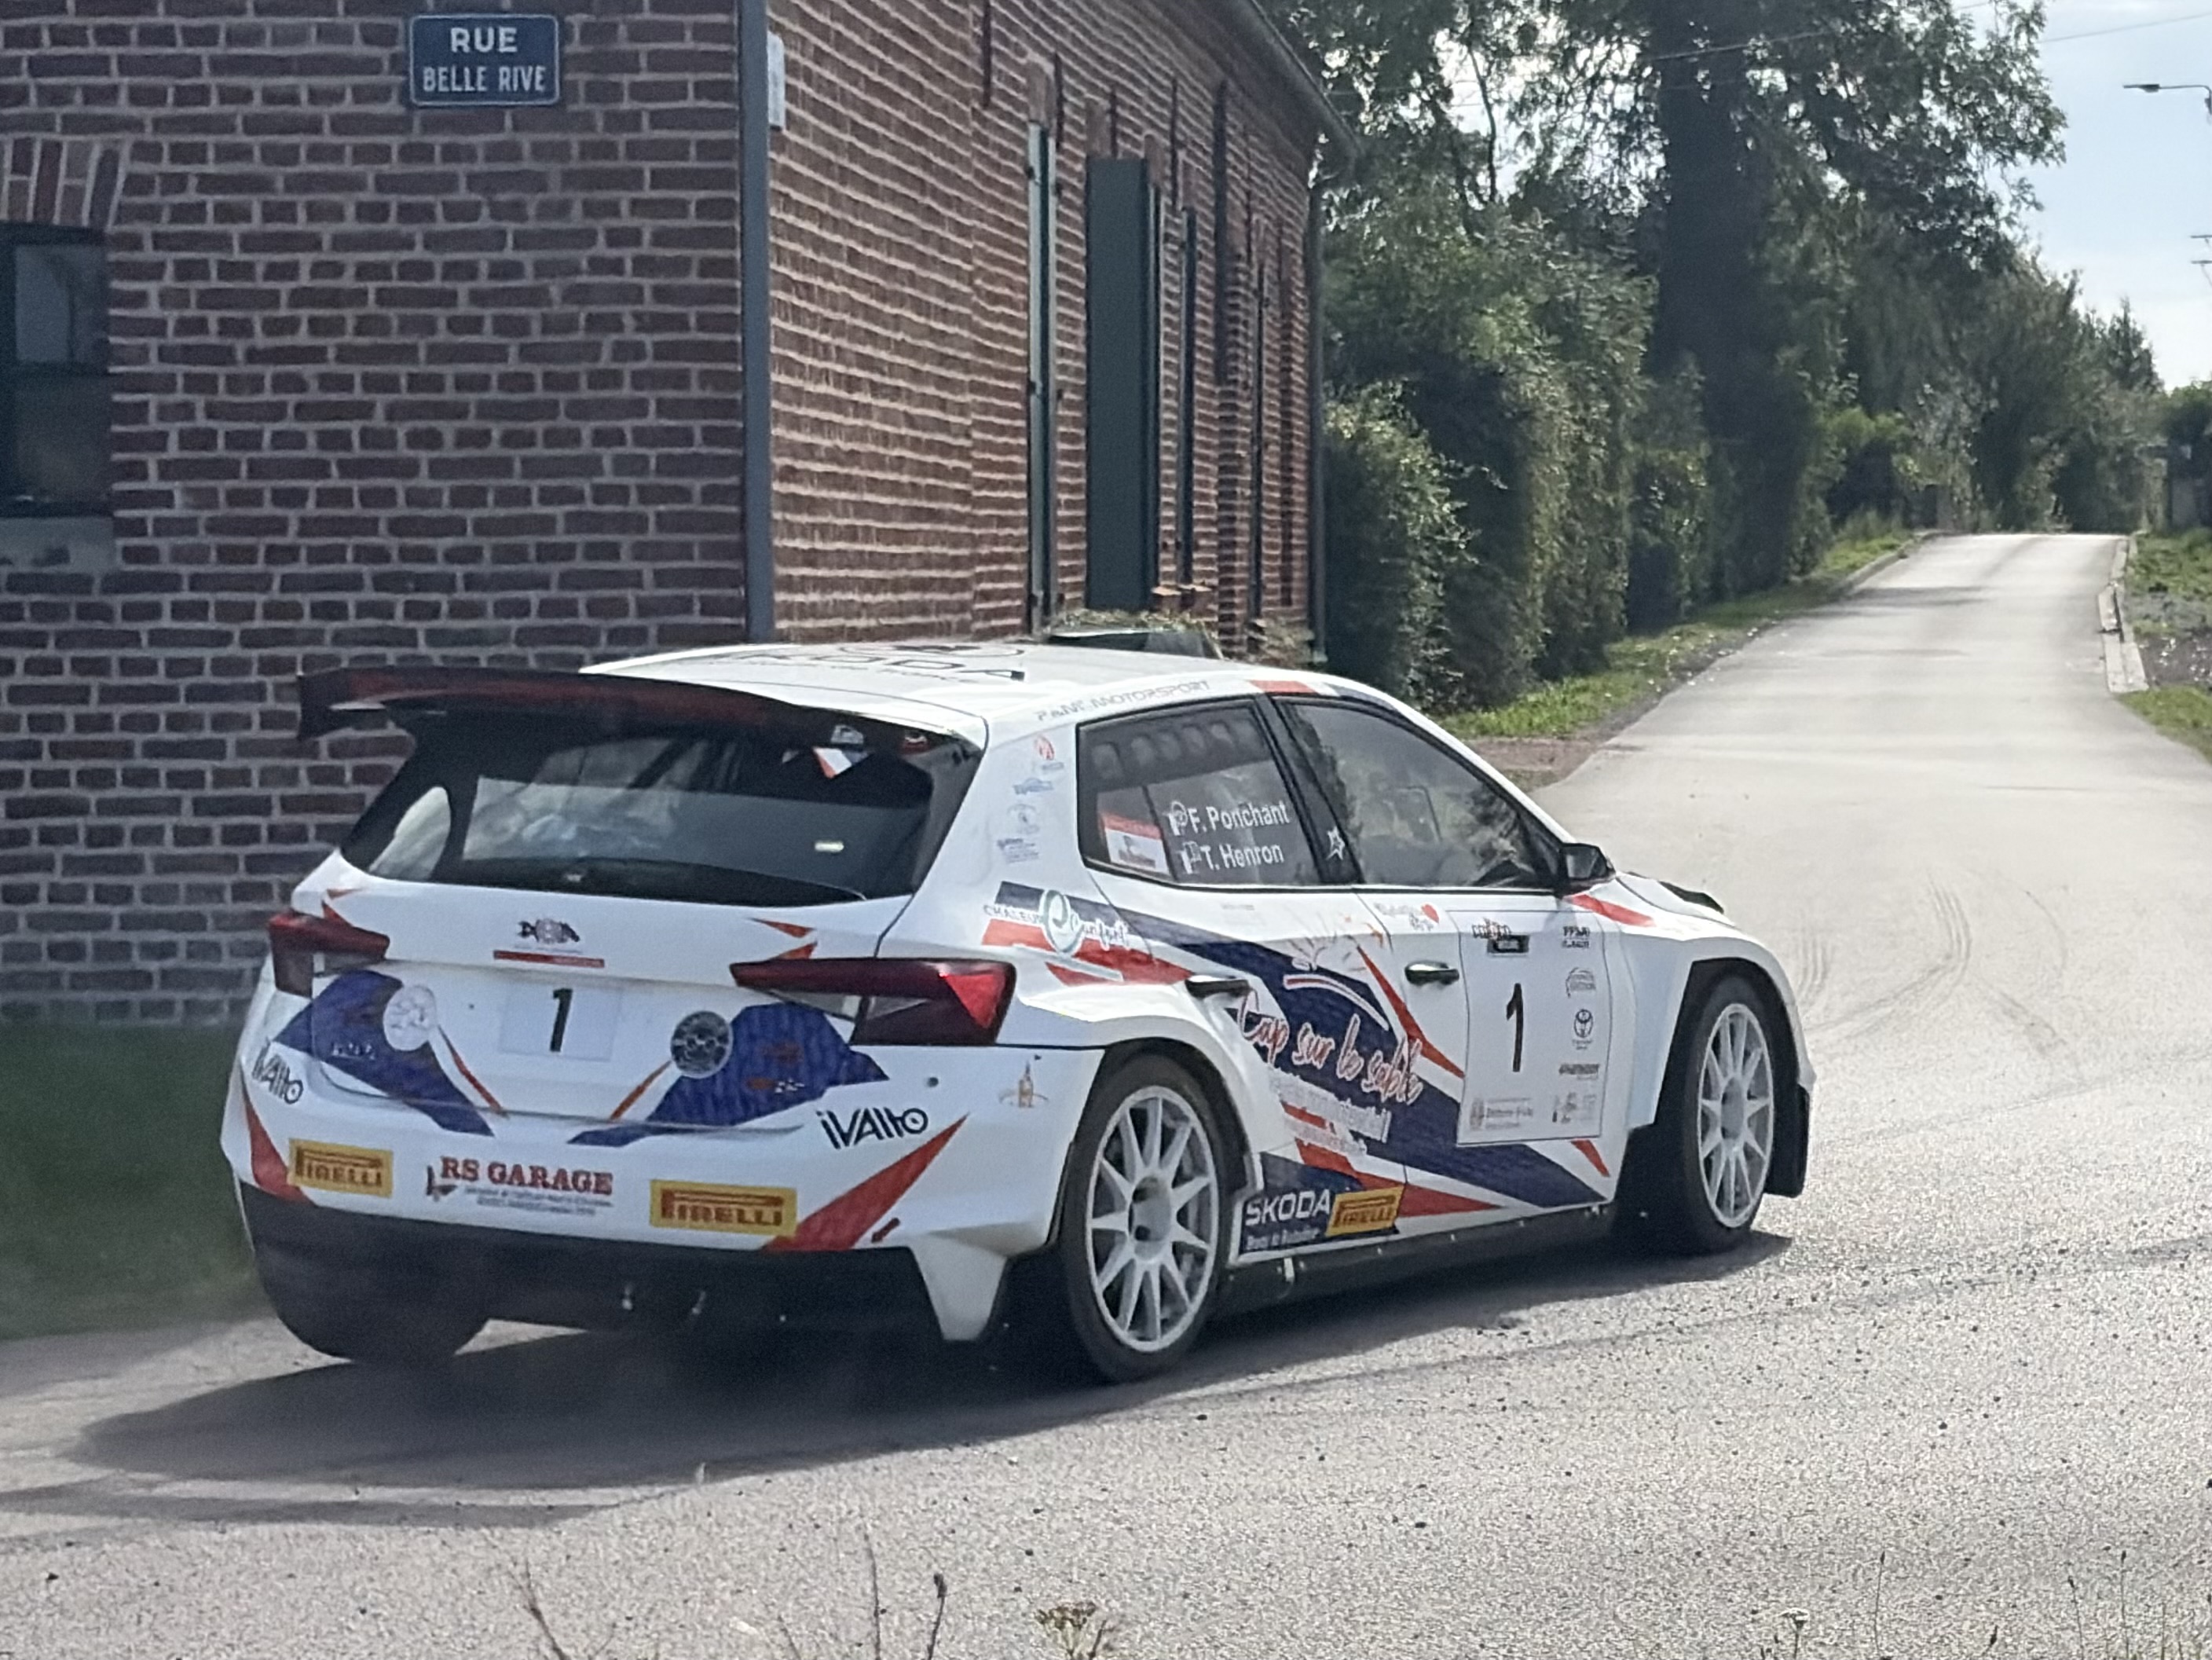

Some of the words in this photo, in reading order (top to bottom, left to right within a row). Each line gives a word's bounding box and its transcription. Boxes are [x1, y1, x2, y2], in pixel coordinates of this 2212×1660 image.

[450, 27, 518, 53] RUE
[422, 65, 488, 93] BELLE
[498, 65, 547, 93] RIVE
[1206, 800, 1291, 831] Ponchant
[1219, 843, 1285, 869] Henron
[549, 988, 574, 1053] 1
[1505, 982, 1524, 1072] 1
[294, 1147, 383, 1189] PIRELLI
[441, 1156, 480, 1182] RS
[487, 1160, 614, 1196] GARAGE
[660, 1187, 784, 1228] PIRELLI
